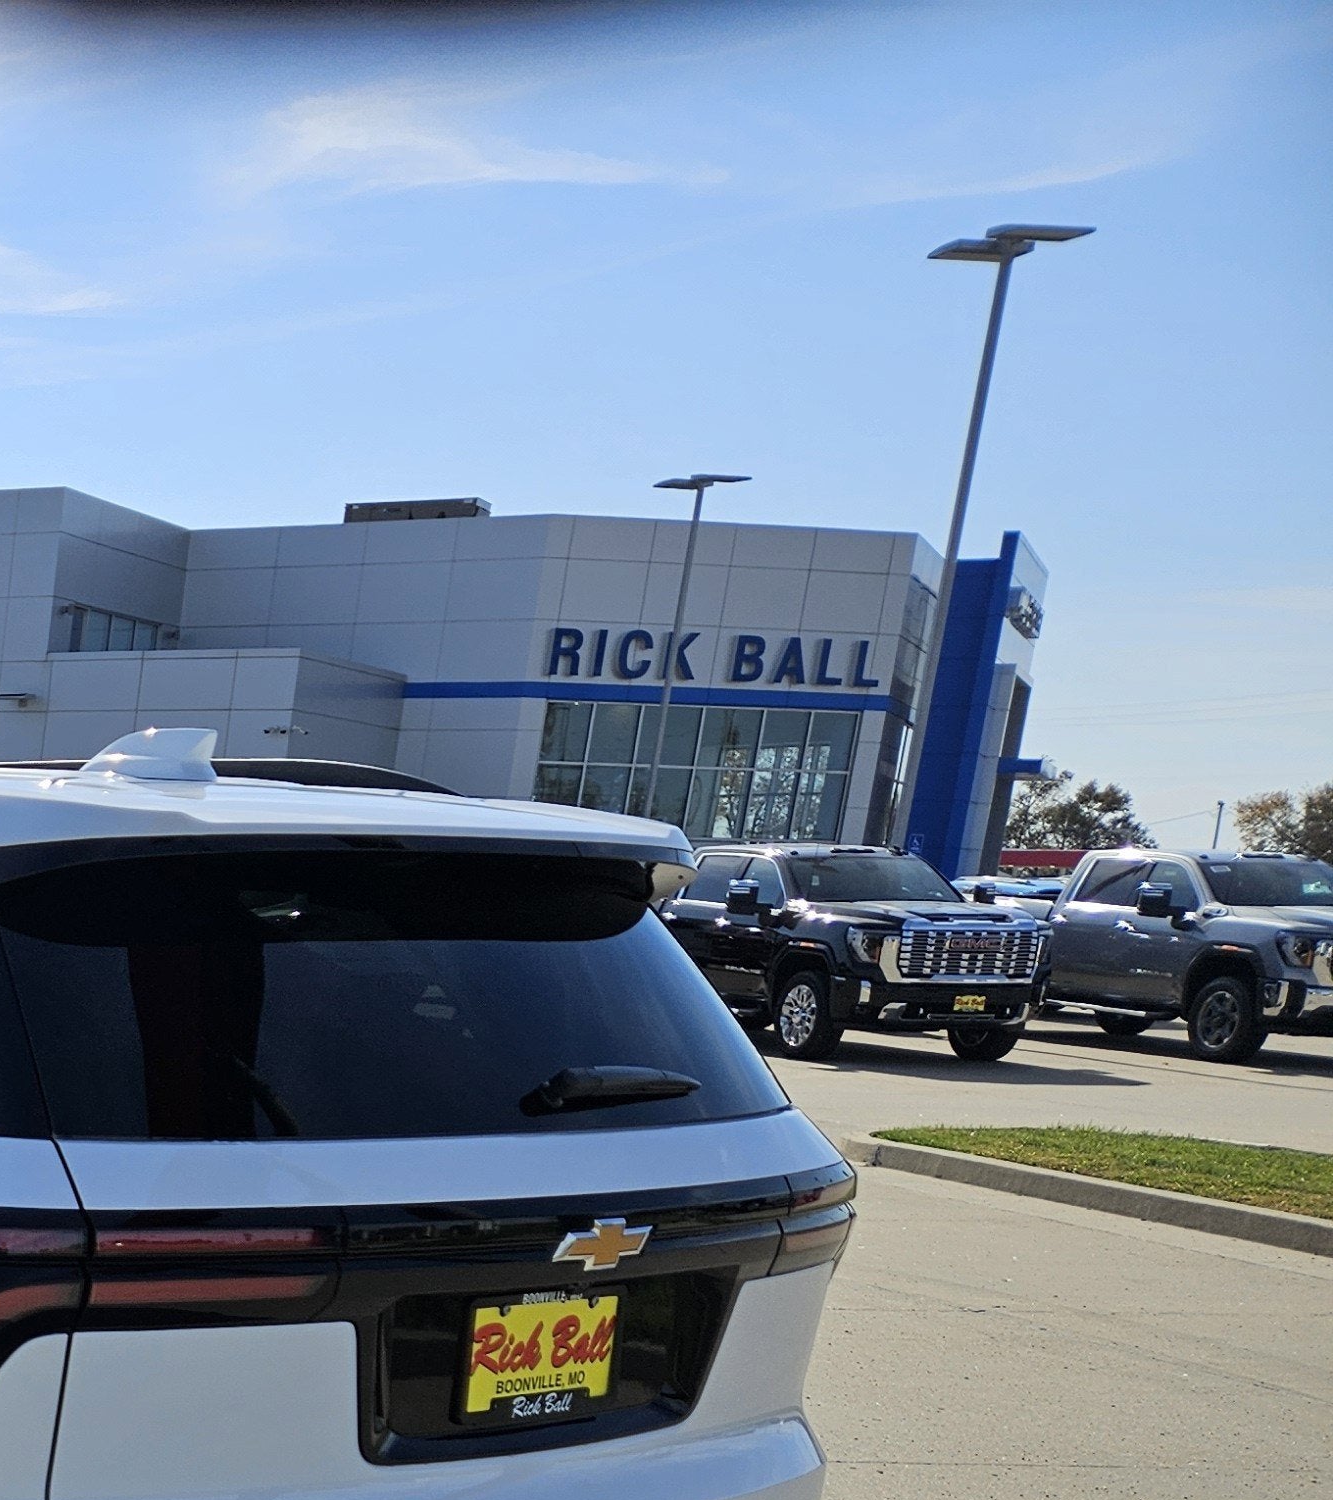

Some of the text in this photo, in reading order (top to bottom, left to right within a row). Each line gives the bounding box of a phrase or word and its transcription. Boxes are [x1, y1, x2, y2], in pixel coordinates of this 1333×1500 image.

[547, 627, 879, 688] RICK BALL
[950, 938, 1003, 949] GMC
[469, 1314, 618, 1376] Rick Ball
[496, 1370, 586, 1394] BOONVILLE, MO
[511, 1392, 573, 1418] Rick Ball
